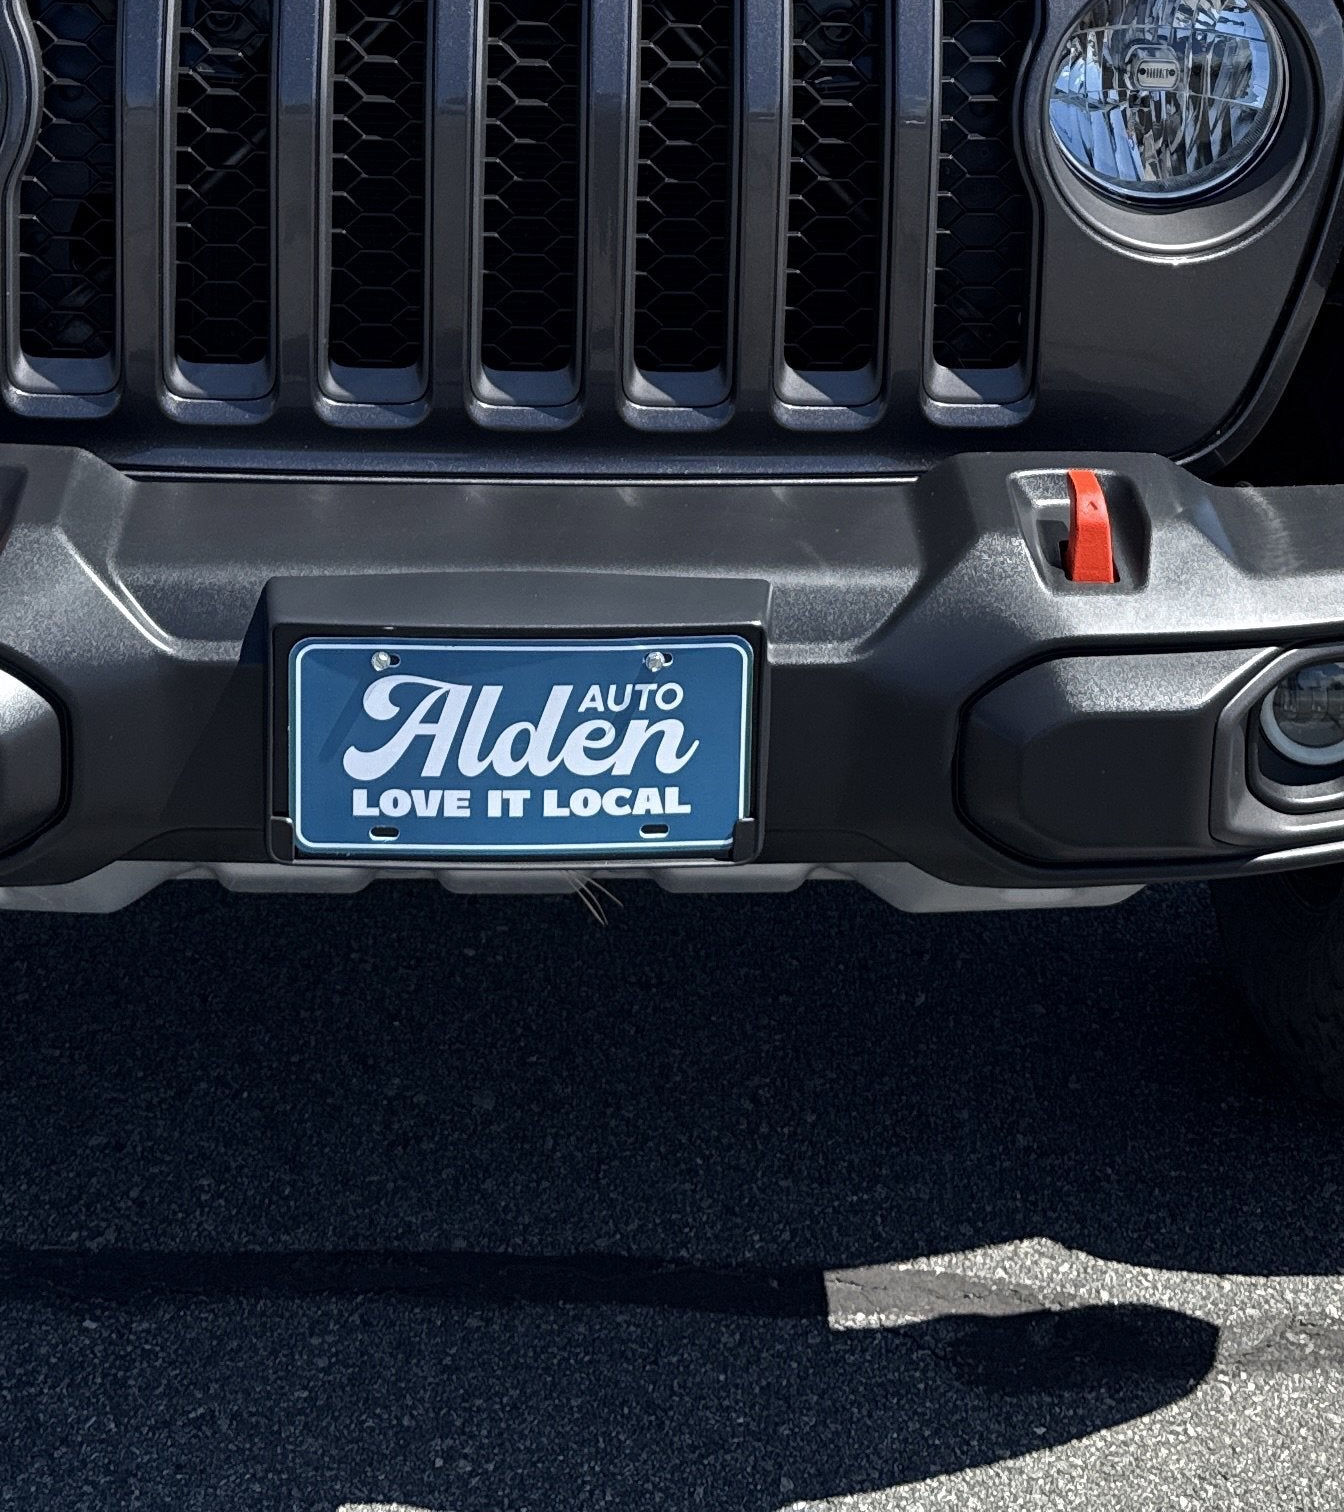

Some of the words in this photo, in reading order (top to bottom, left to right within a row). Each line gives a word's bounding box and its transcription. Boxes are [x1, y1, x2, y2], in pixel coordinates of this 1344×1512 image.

[578, 682, 683, 712] AUTO
[343, 675, 699, 780] Alden
[353, 788, 470, 817] LOVE
[488, 790, 530, 817] IT
[544, 787, 691, 816] LOCAL
